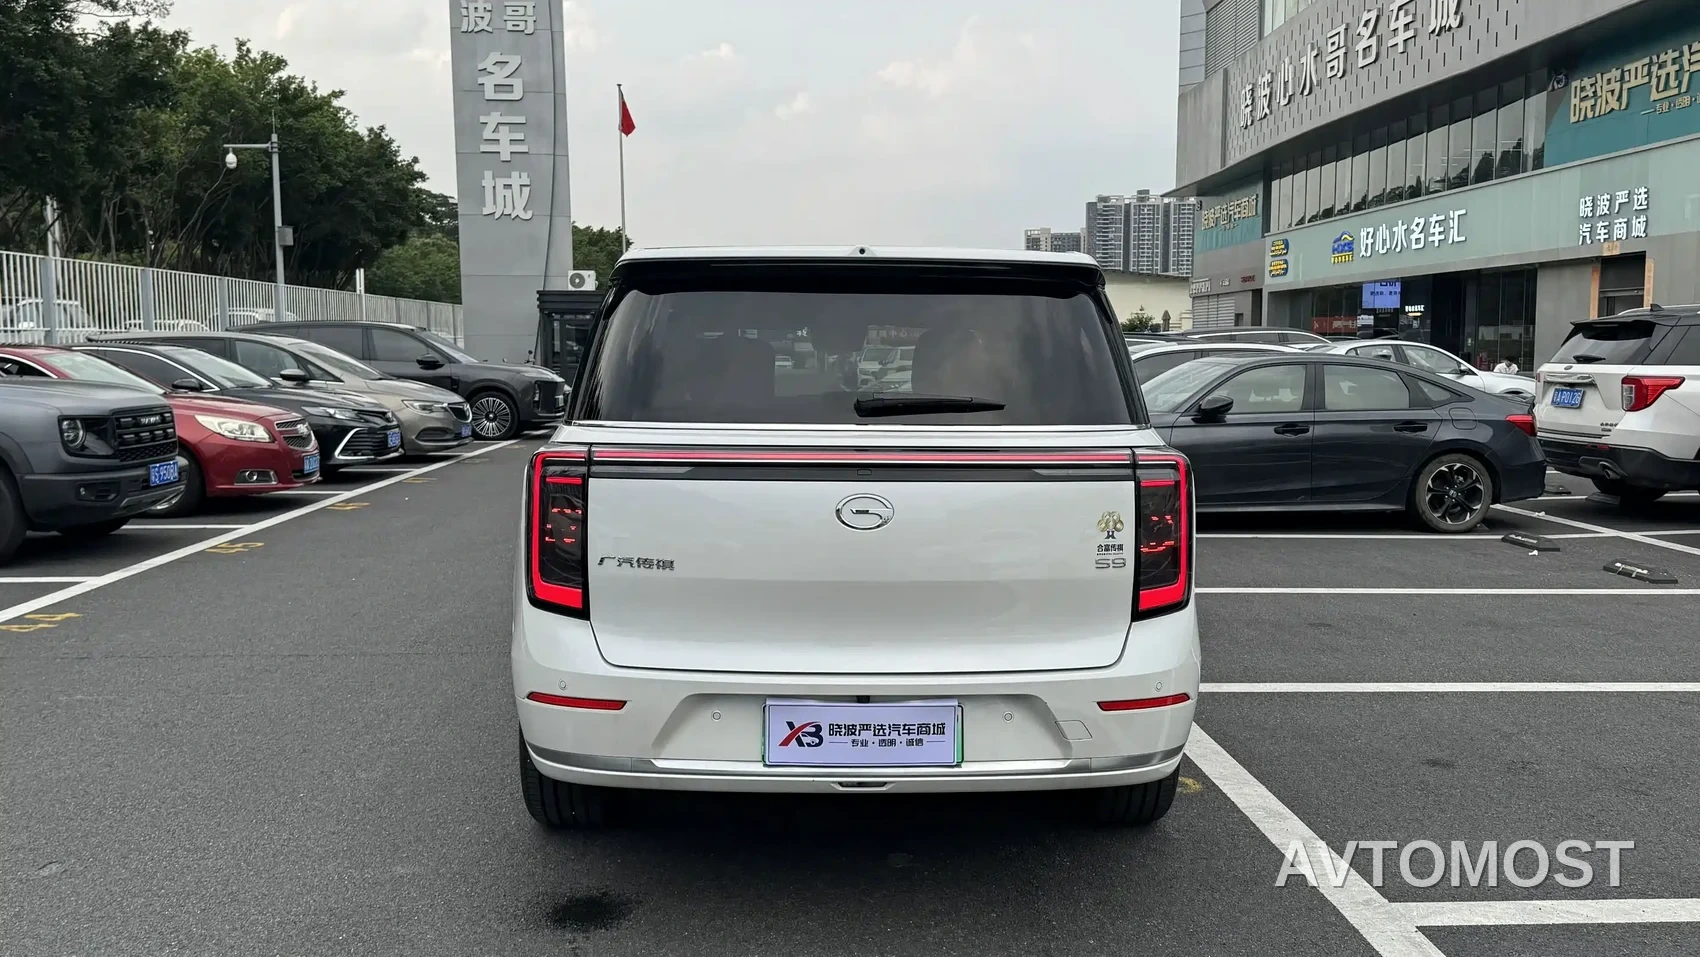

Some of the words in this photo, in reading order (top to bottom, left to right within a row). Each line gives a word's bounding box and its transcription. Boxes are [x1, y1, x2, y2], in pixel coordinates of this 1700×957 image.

[477, 51, 533, 220] 名车城
[1579, 186, 1648, 217] 晓波严选
[1360, 209, 1467, 258] 好心水名车汇
[1579, 215, 1647, 245] 汽车商城
[598, 556, 675, 571] 广汽传祺
[828, 722, 946, 737] 晓波严选汽车商城
